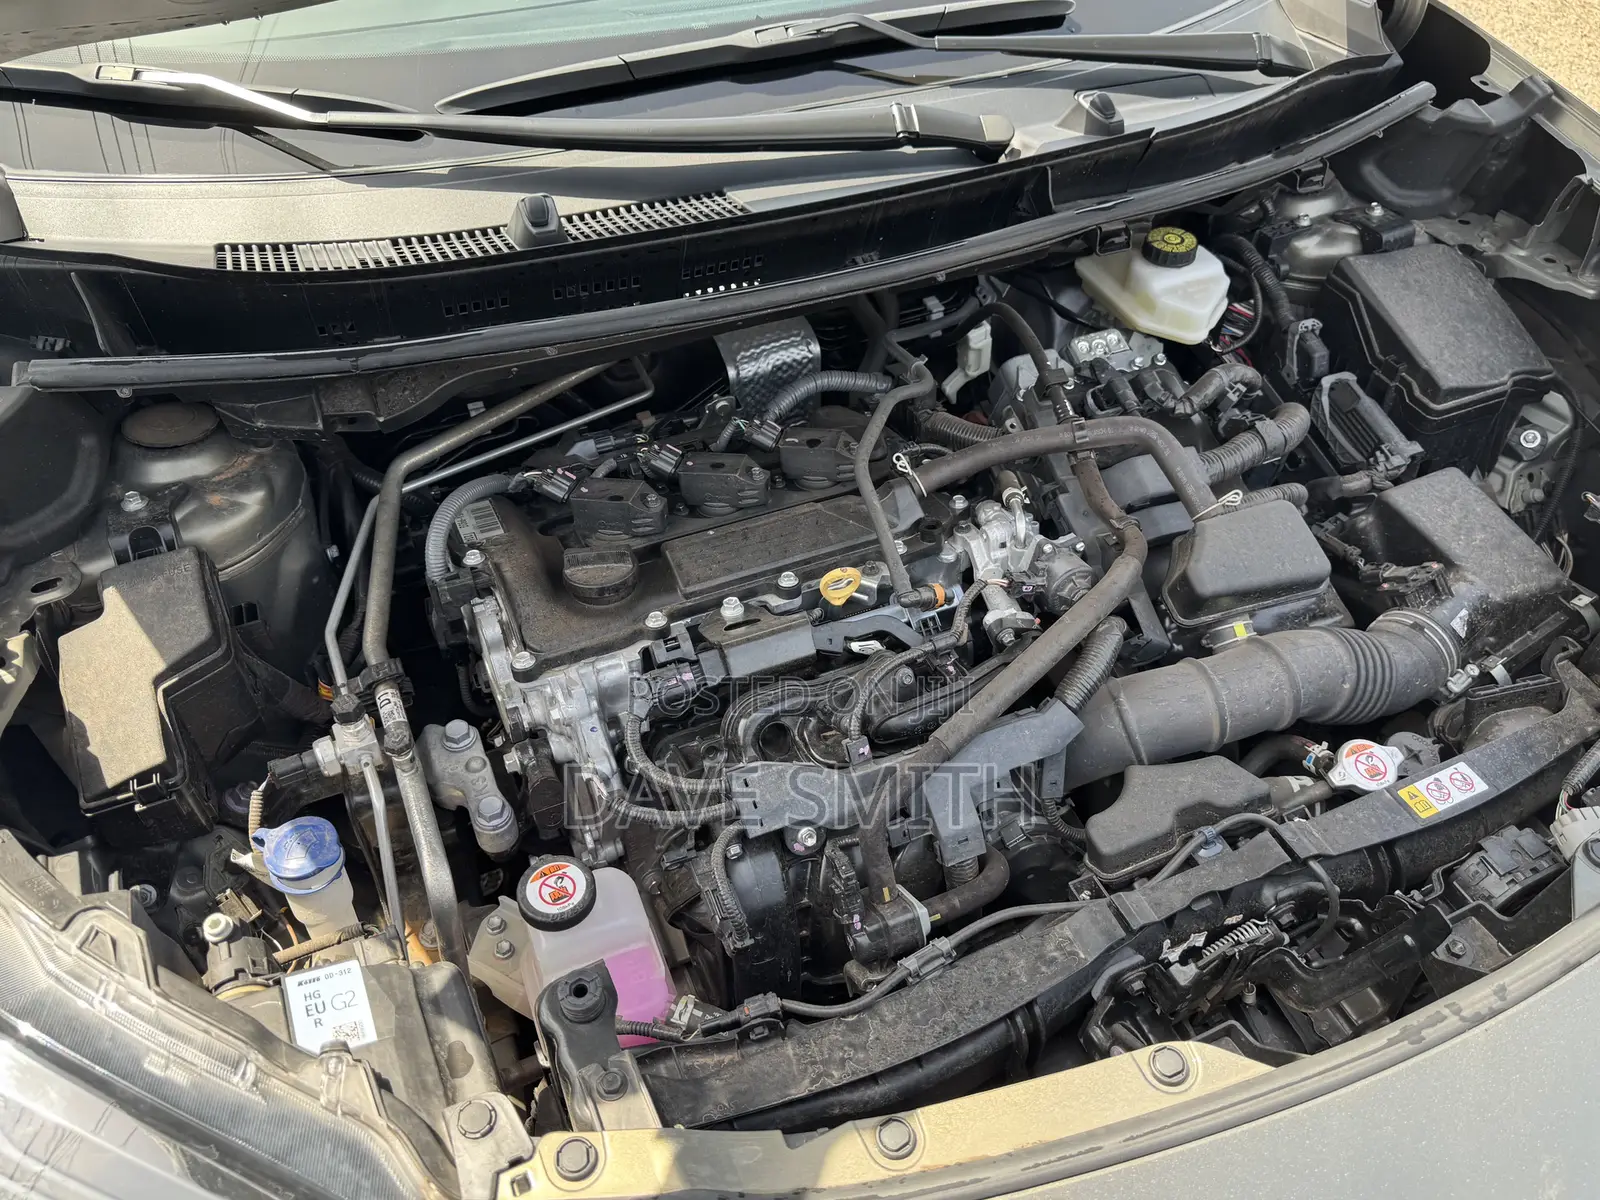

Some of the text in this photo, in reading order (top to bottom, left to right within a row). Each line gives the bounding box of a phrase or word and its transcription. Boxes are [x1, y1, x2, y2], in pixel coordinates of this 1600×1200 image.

[303, 989, 321, 1002] HG
[330, 990, 358, 1011] G2
[305, 1000, 327, 1018] EU
[314, 1018, 323, 1028] R
